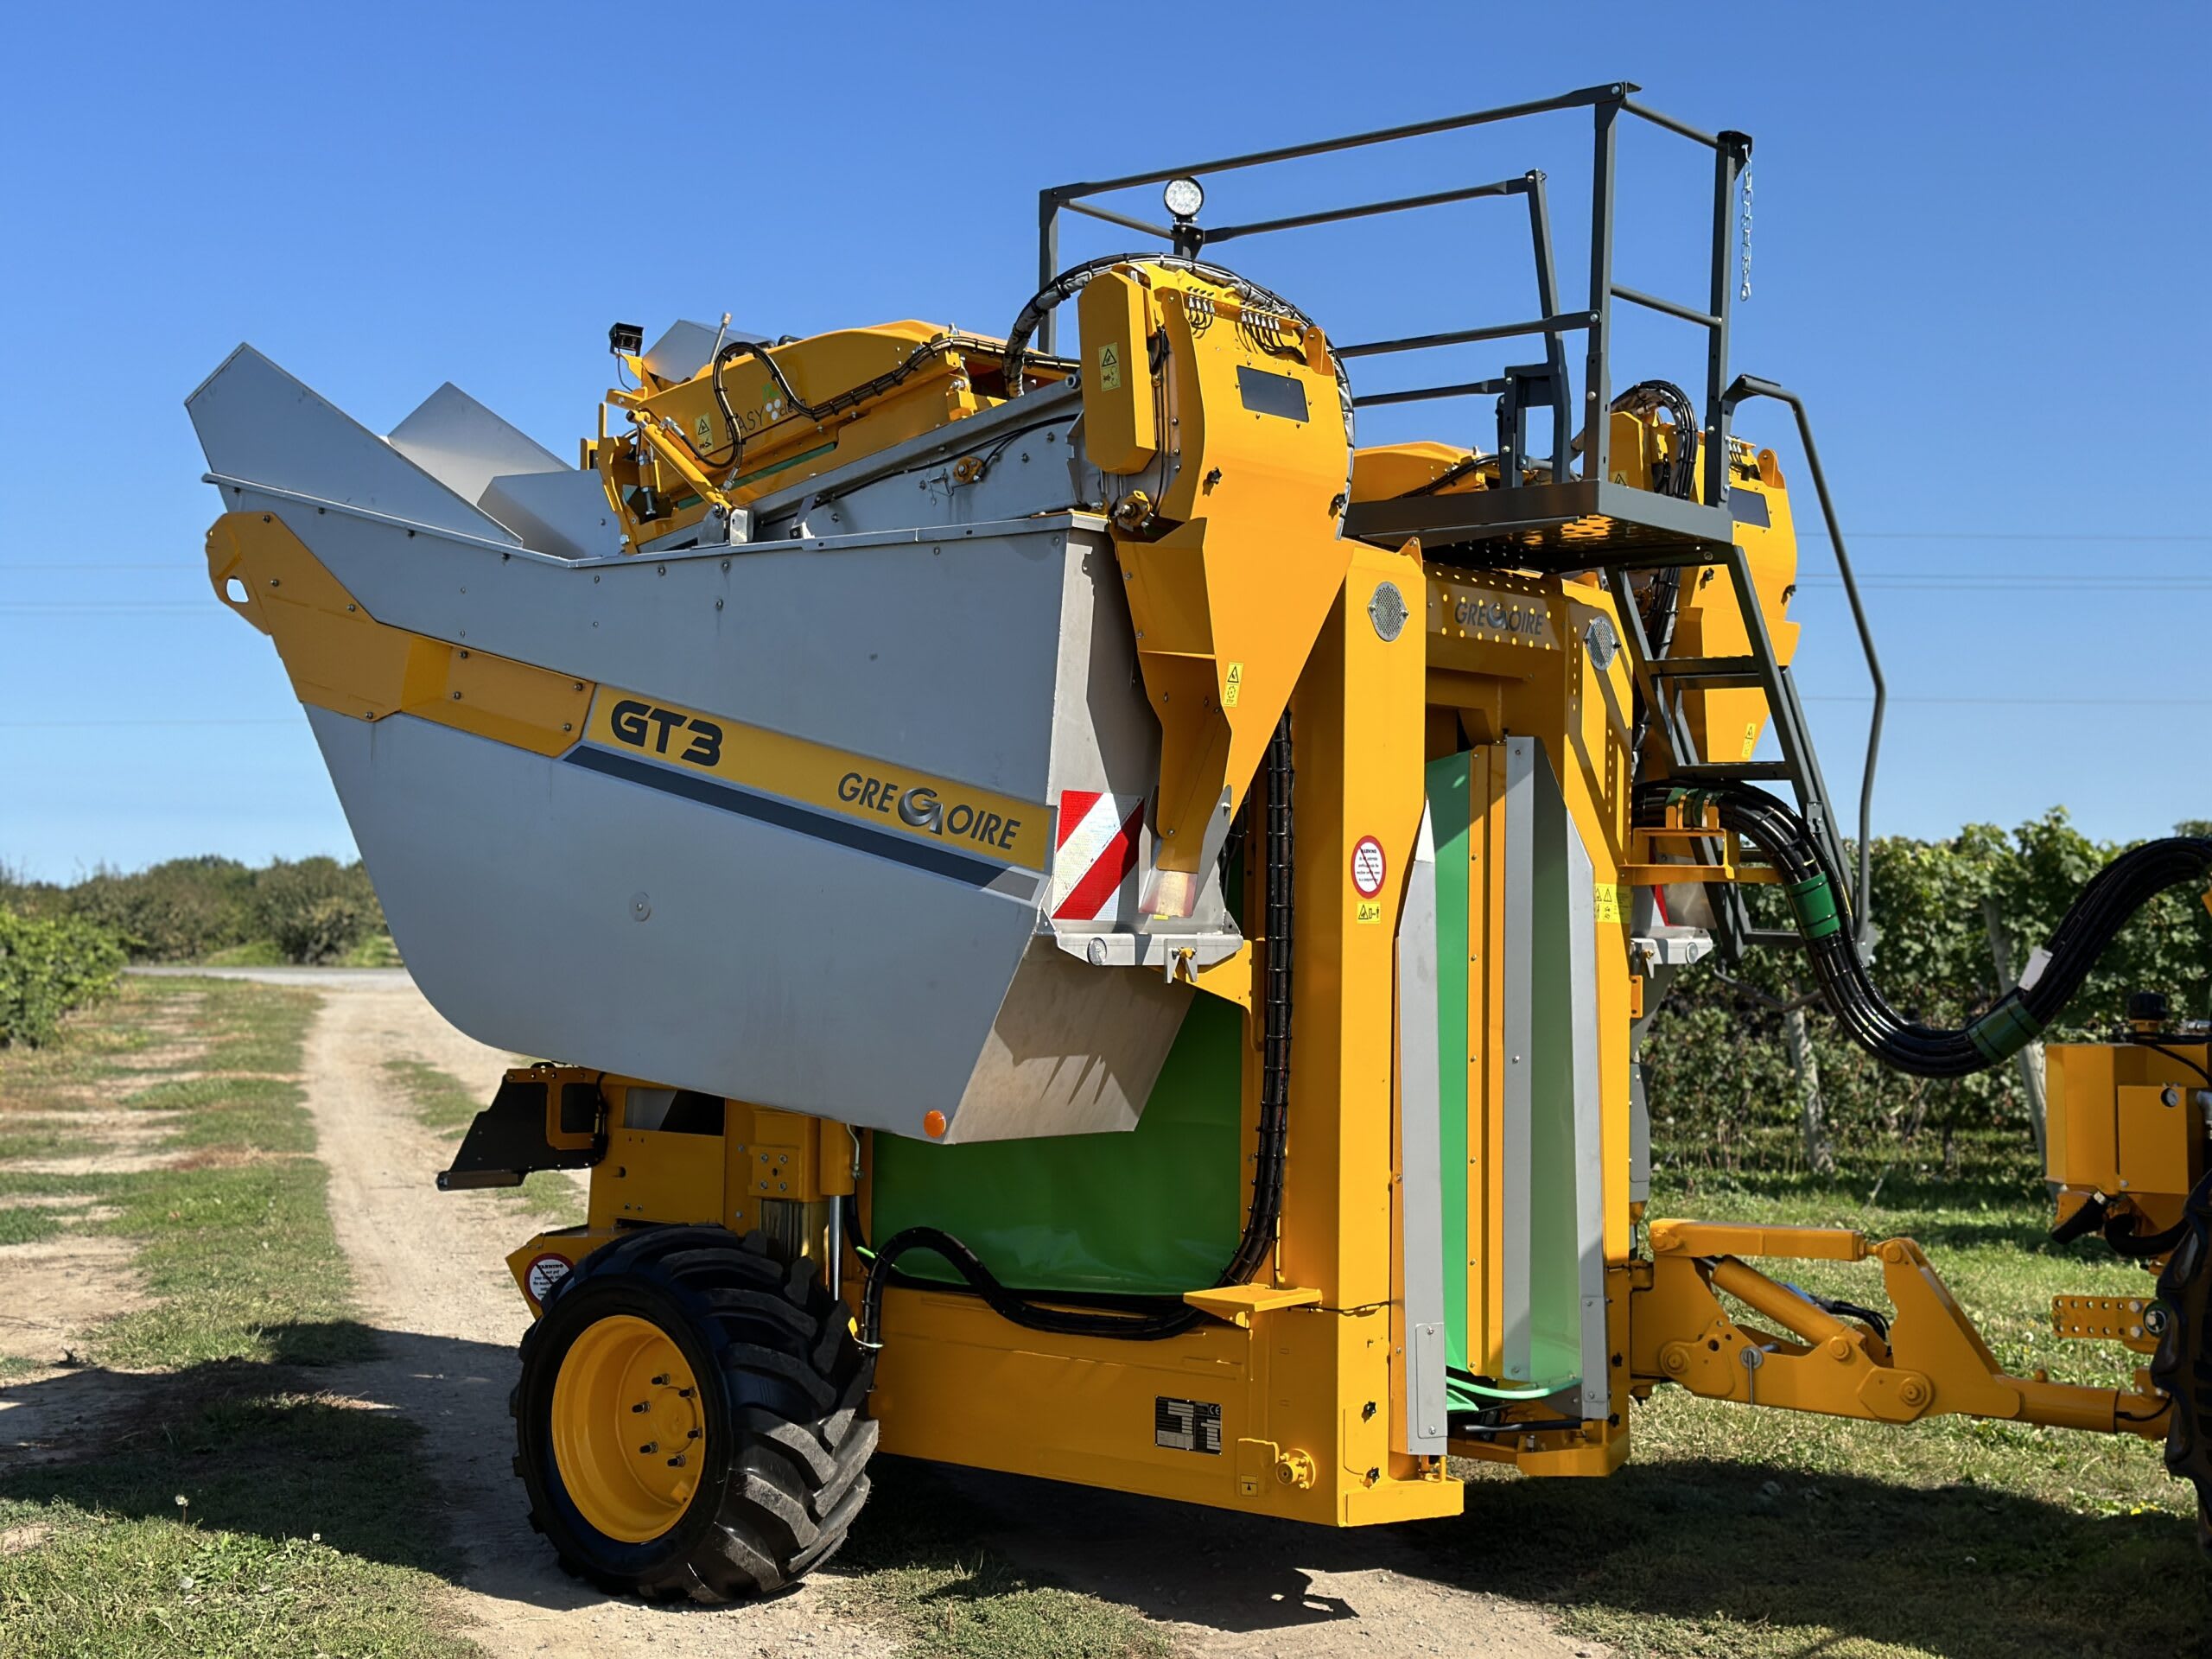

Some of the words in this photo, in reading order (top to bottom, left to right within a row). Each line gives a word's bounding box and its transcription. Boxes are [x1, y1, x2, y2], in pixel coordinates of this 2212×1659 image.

[1454, 601, 1545, 635] GREGOIRE
[611, 700, 723, 766] GT3
[837, 772, 1021, 850] GREGOIRE
